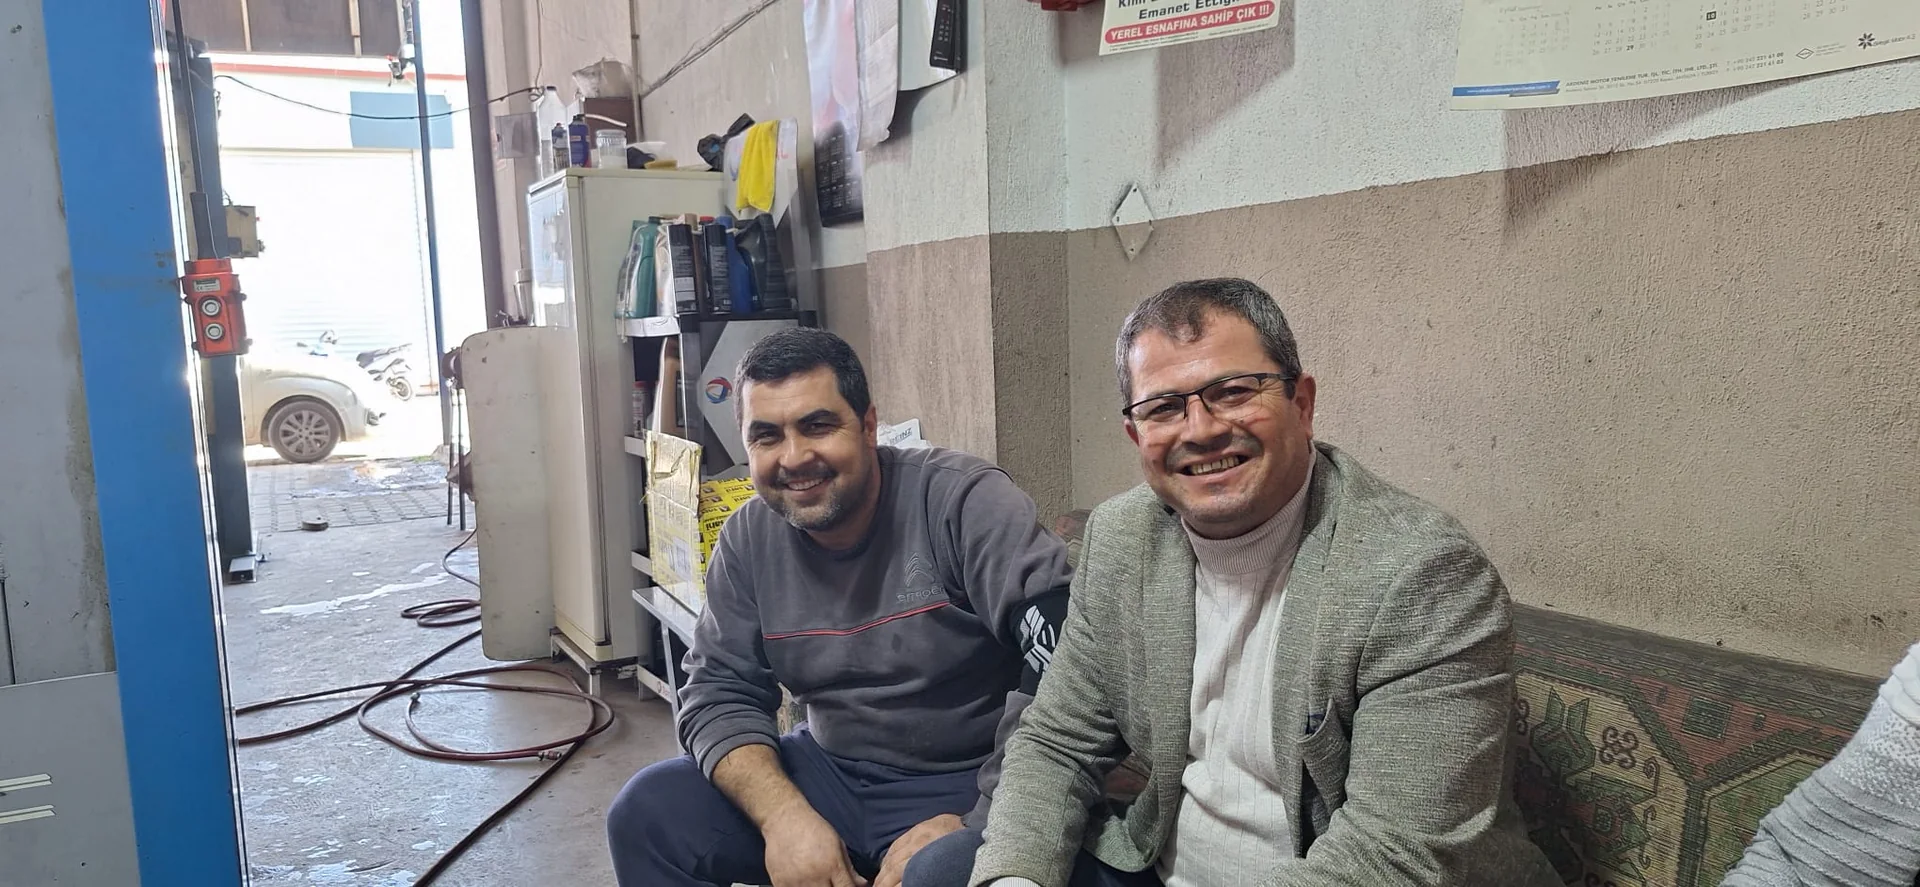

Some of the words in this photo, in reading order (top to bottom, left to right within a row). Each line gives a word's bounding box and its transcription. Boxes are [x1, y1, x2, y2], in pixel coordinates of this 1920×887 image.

[1139, 3, 1190, 19] Emanet
[1707, 12, 1716, 20] 10
[1110, 28, 1143, 40] YEREL
[1146, 17, 1198, 35] ESNAFINA
[1200, 10, 1234, 25] SAHİP
[1236, 7, 1257, 21] ÇIK
[1259, 4, 1270, 15] !!!
